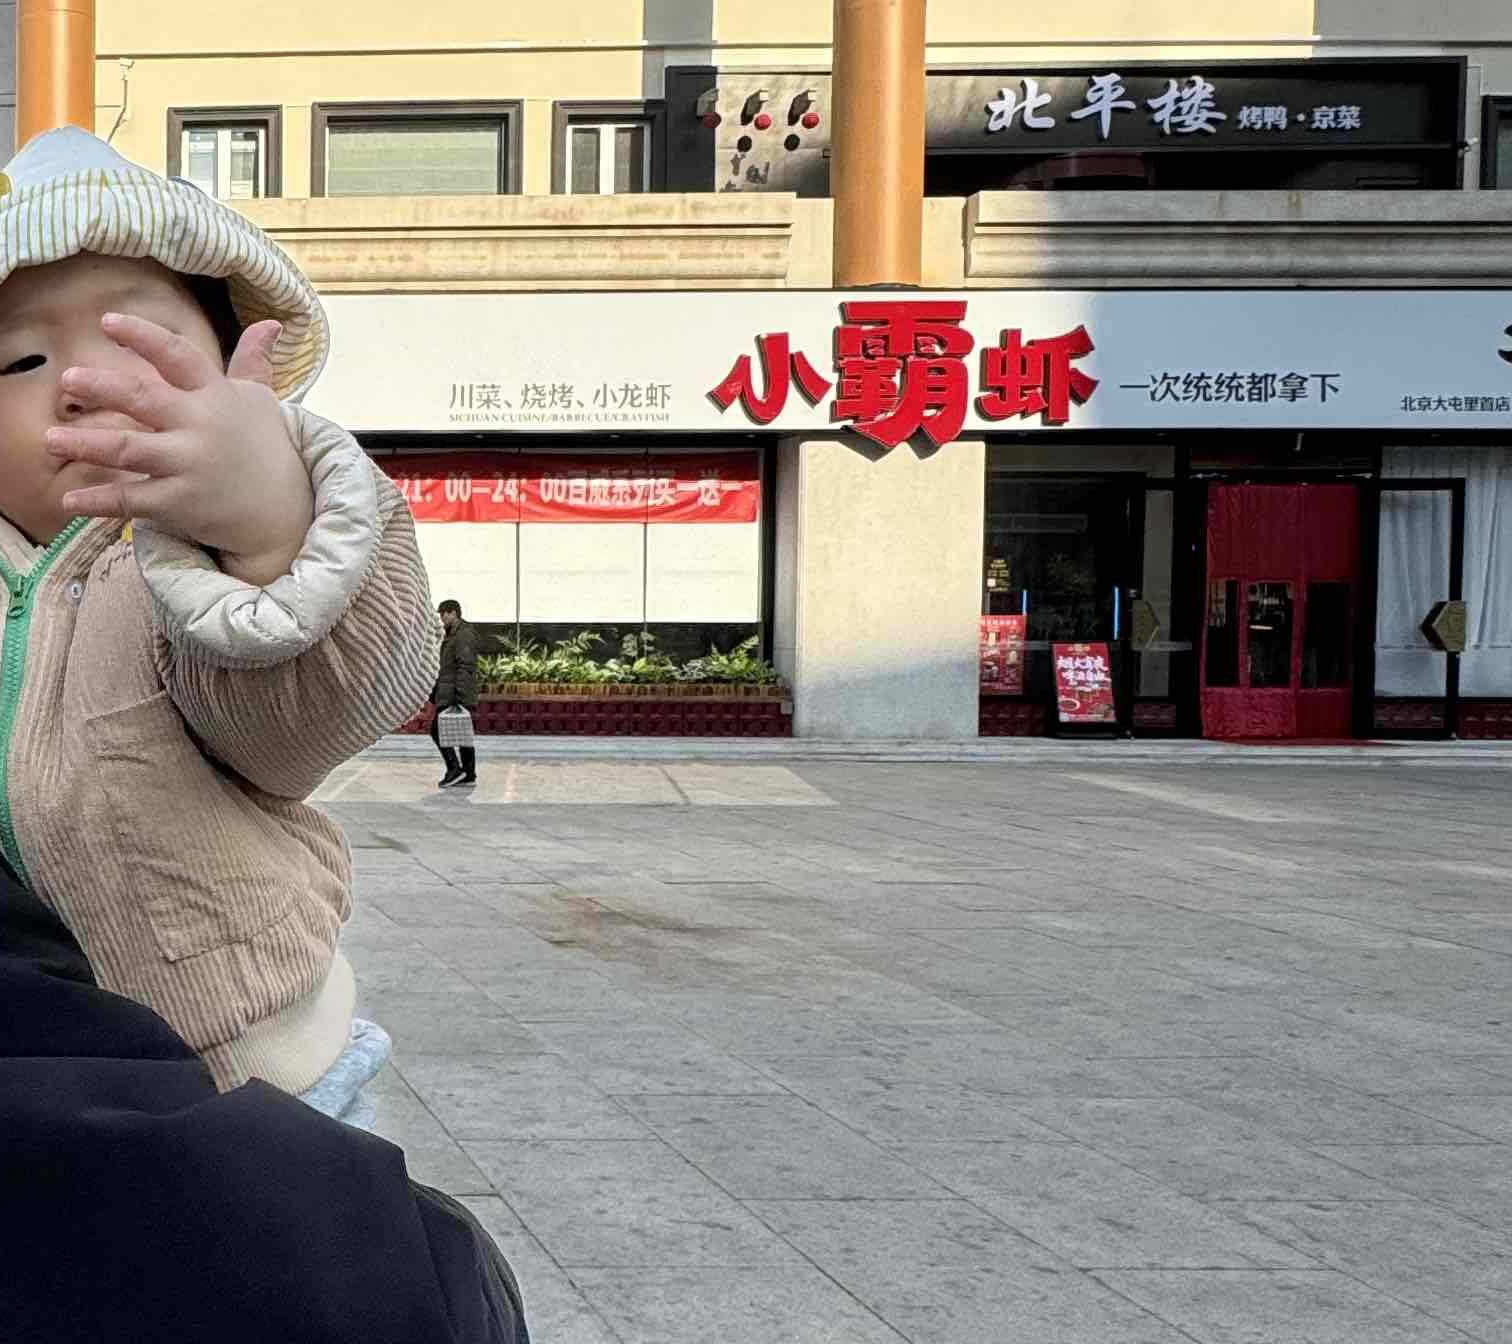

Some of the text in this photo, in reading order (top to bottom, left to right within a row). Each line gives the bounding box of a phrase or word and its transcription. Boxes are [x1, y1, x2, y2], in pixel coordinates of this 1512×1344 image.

[987, 72, 1227, 140] 北平楼
[705, 299, 1100, 453] 小霸虾
[1119, 372, 1342, 403] 一次统统都拿下
[449, 382, 673, 410] 川菜、烧烤、小龙虾
[1399, 395, 1511, 412] 北京大屯里首店
